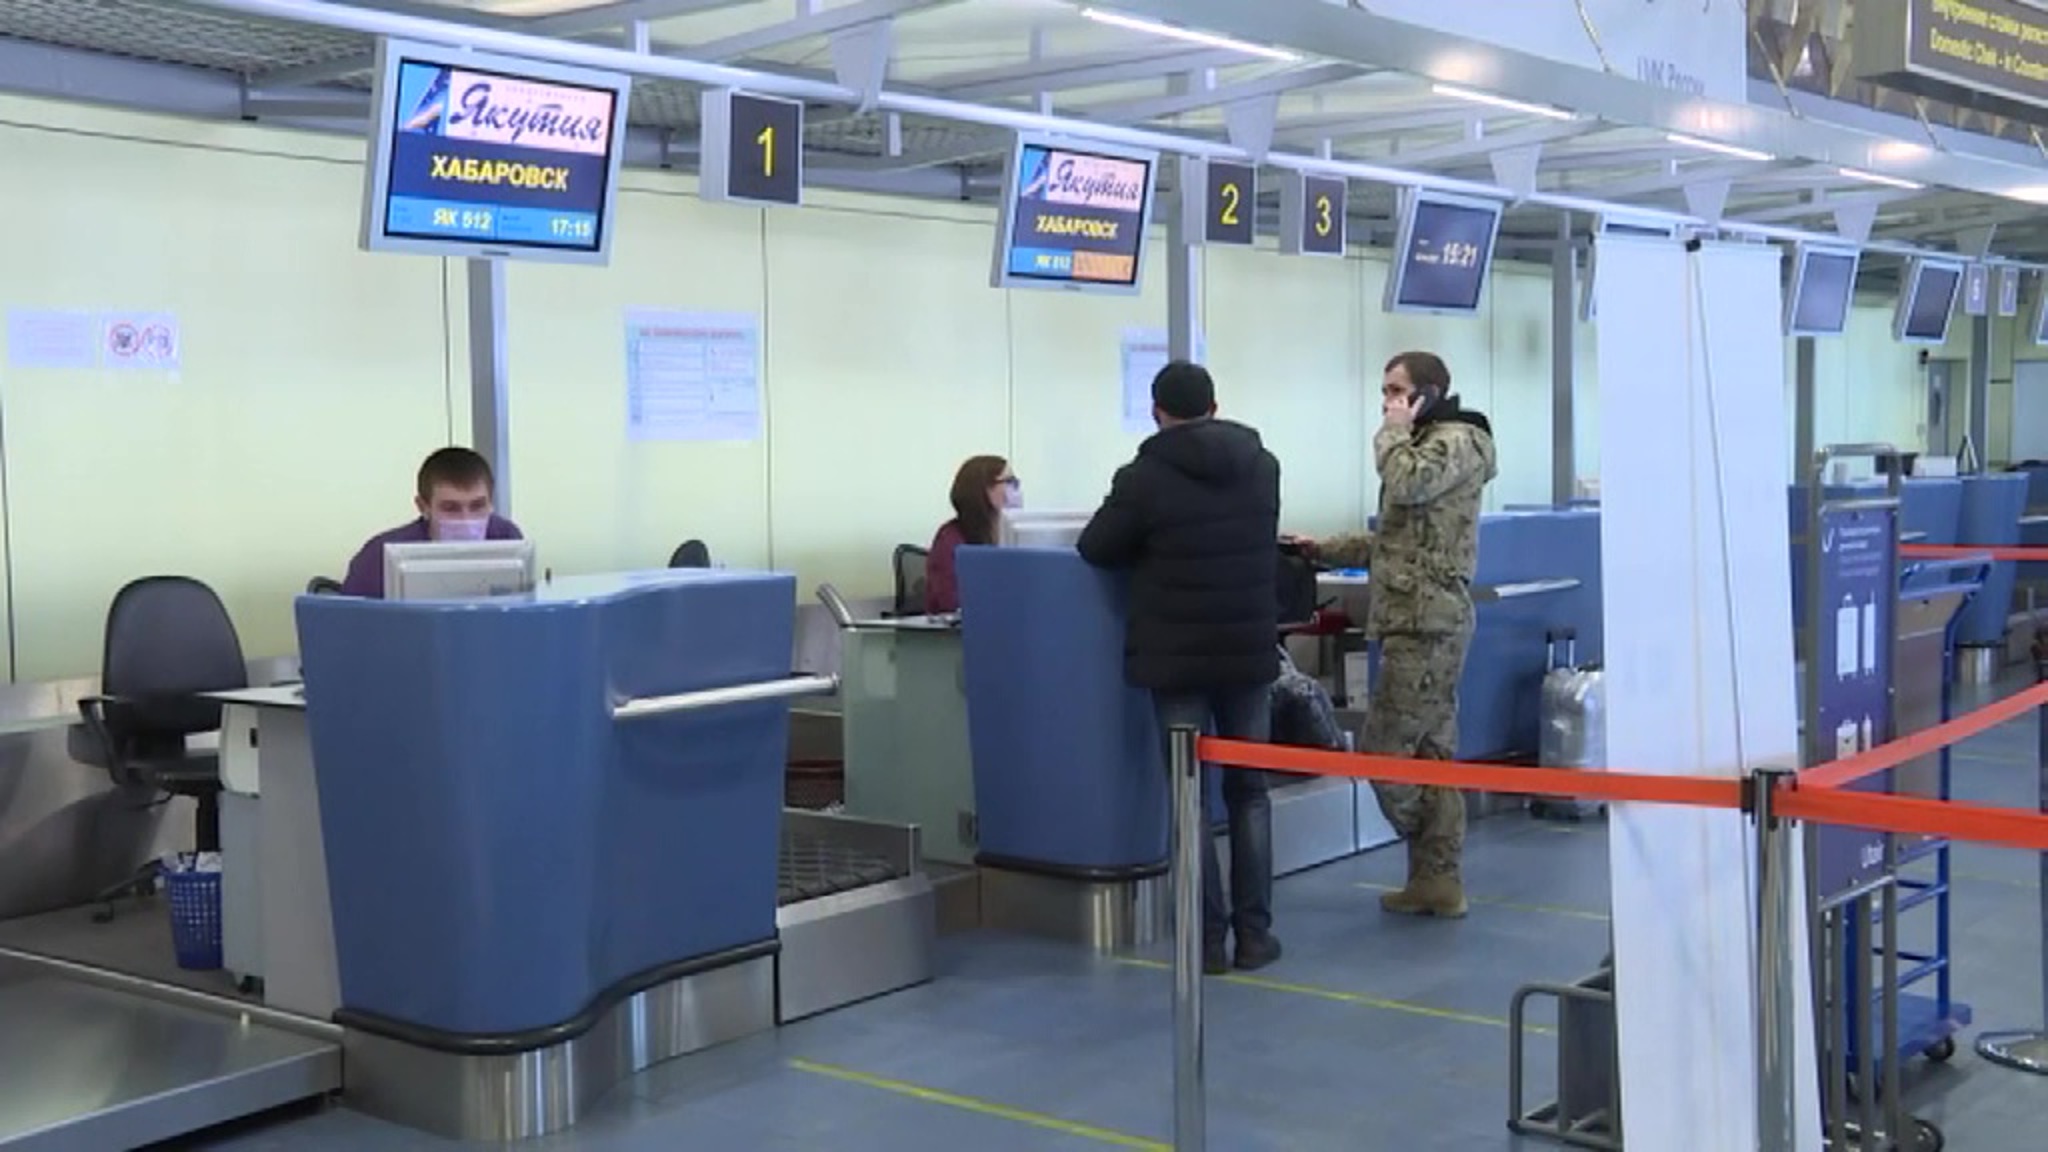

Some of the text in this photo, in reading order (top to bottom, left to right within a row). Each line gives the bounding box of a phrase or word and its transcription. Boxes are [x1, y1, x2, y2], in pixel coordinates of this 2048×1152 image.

[449, 83, 603, 142] Якутия
[756, 124, 775, 178] 1
[431, 154, 569, 192] ХАБАРОВСК
[1049, 159, 1140, 202] Якутия
[1220, 182, 1240, 225] 2
[1315, 195, 1332, 237] 3
[1035, 214, 1119, 240] ХАБАРОВСК
